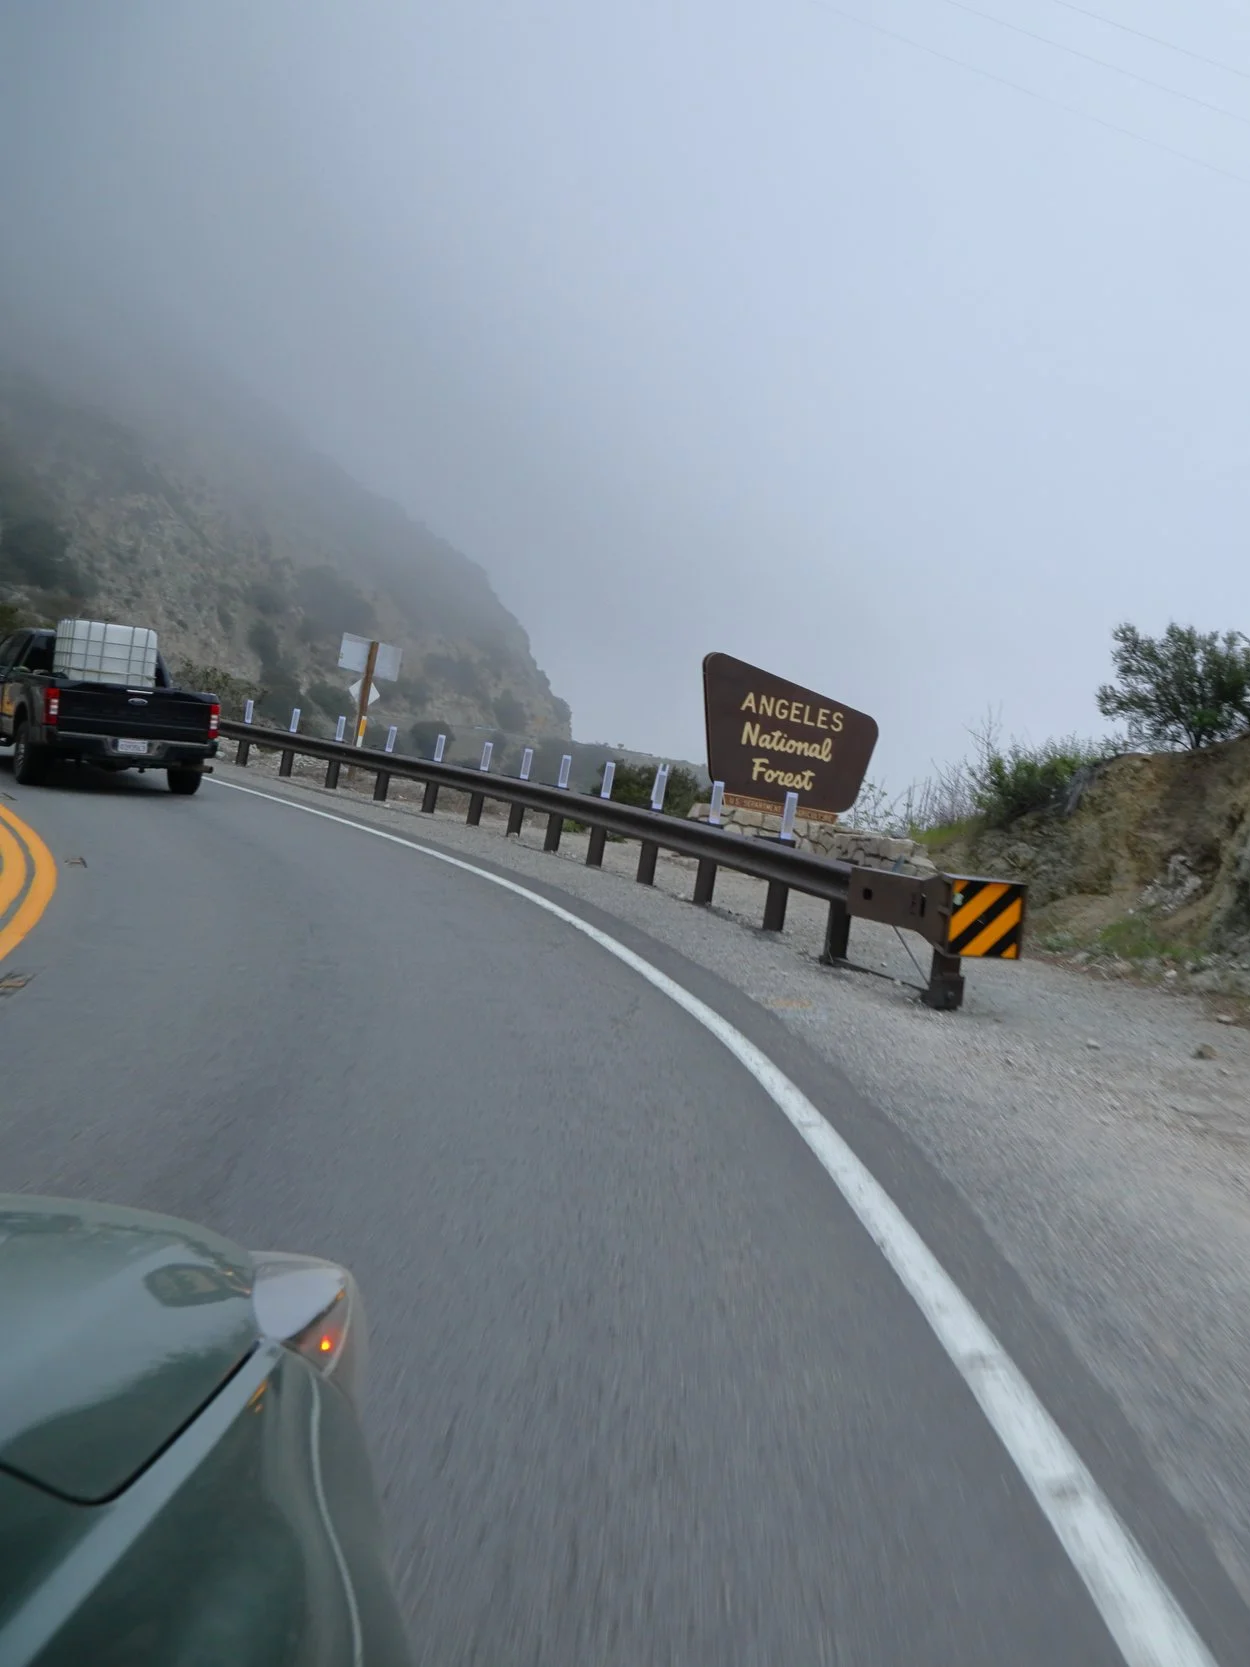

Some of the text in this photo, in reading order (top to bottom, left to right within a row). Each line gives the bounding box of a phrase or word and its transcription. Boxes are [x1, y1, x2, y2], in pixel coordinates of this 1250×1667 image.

[740, 692, 844, 732] ANGELES
[741, 721, 832, 762] National
[752, 758, 816, 791] Forest
